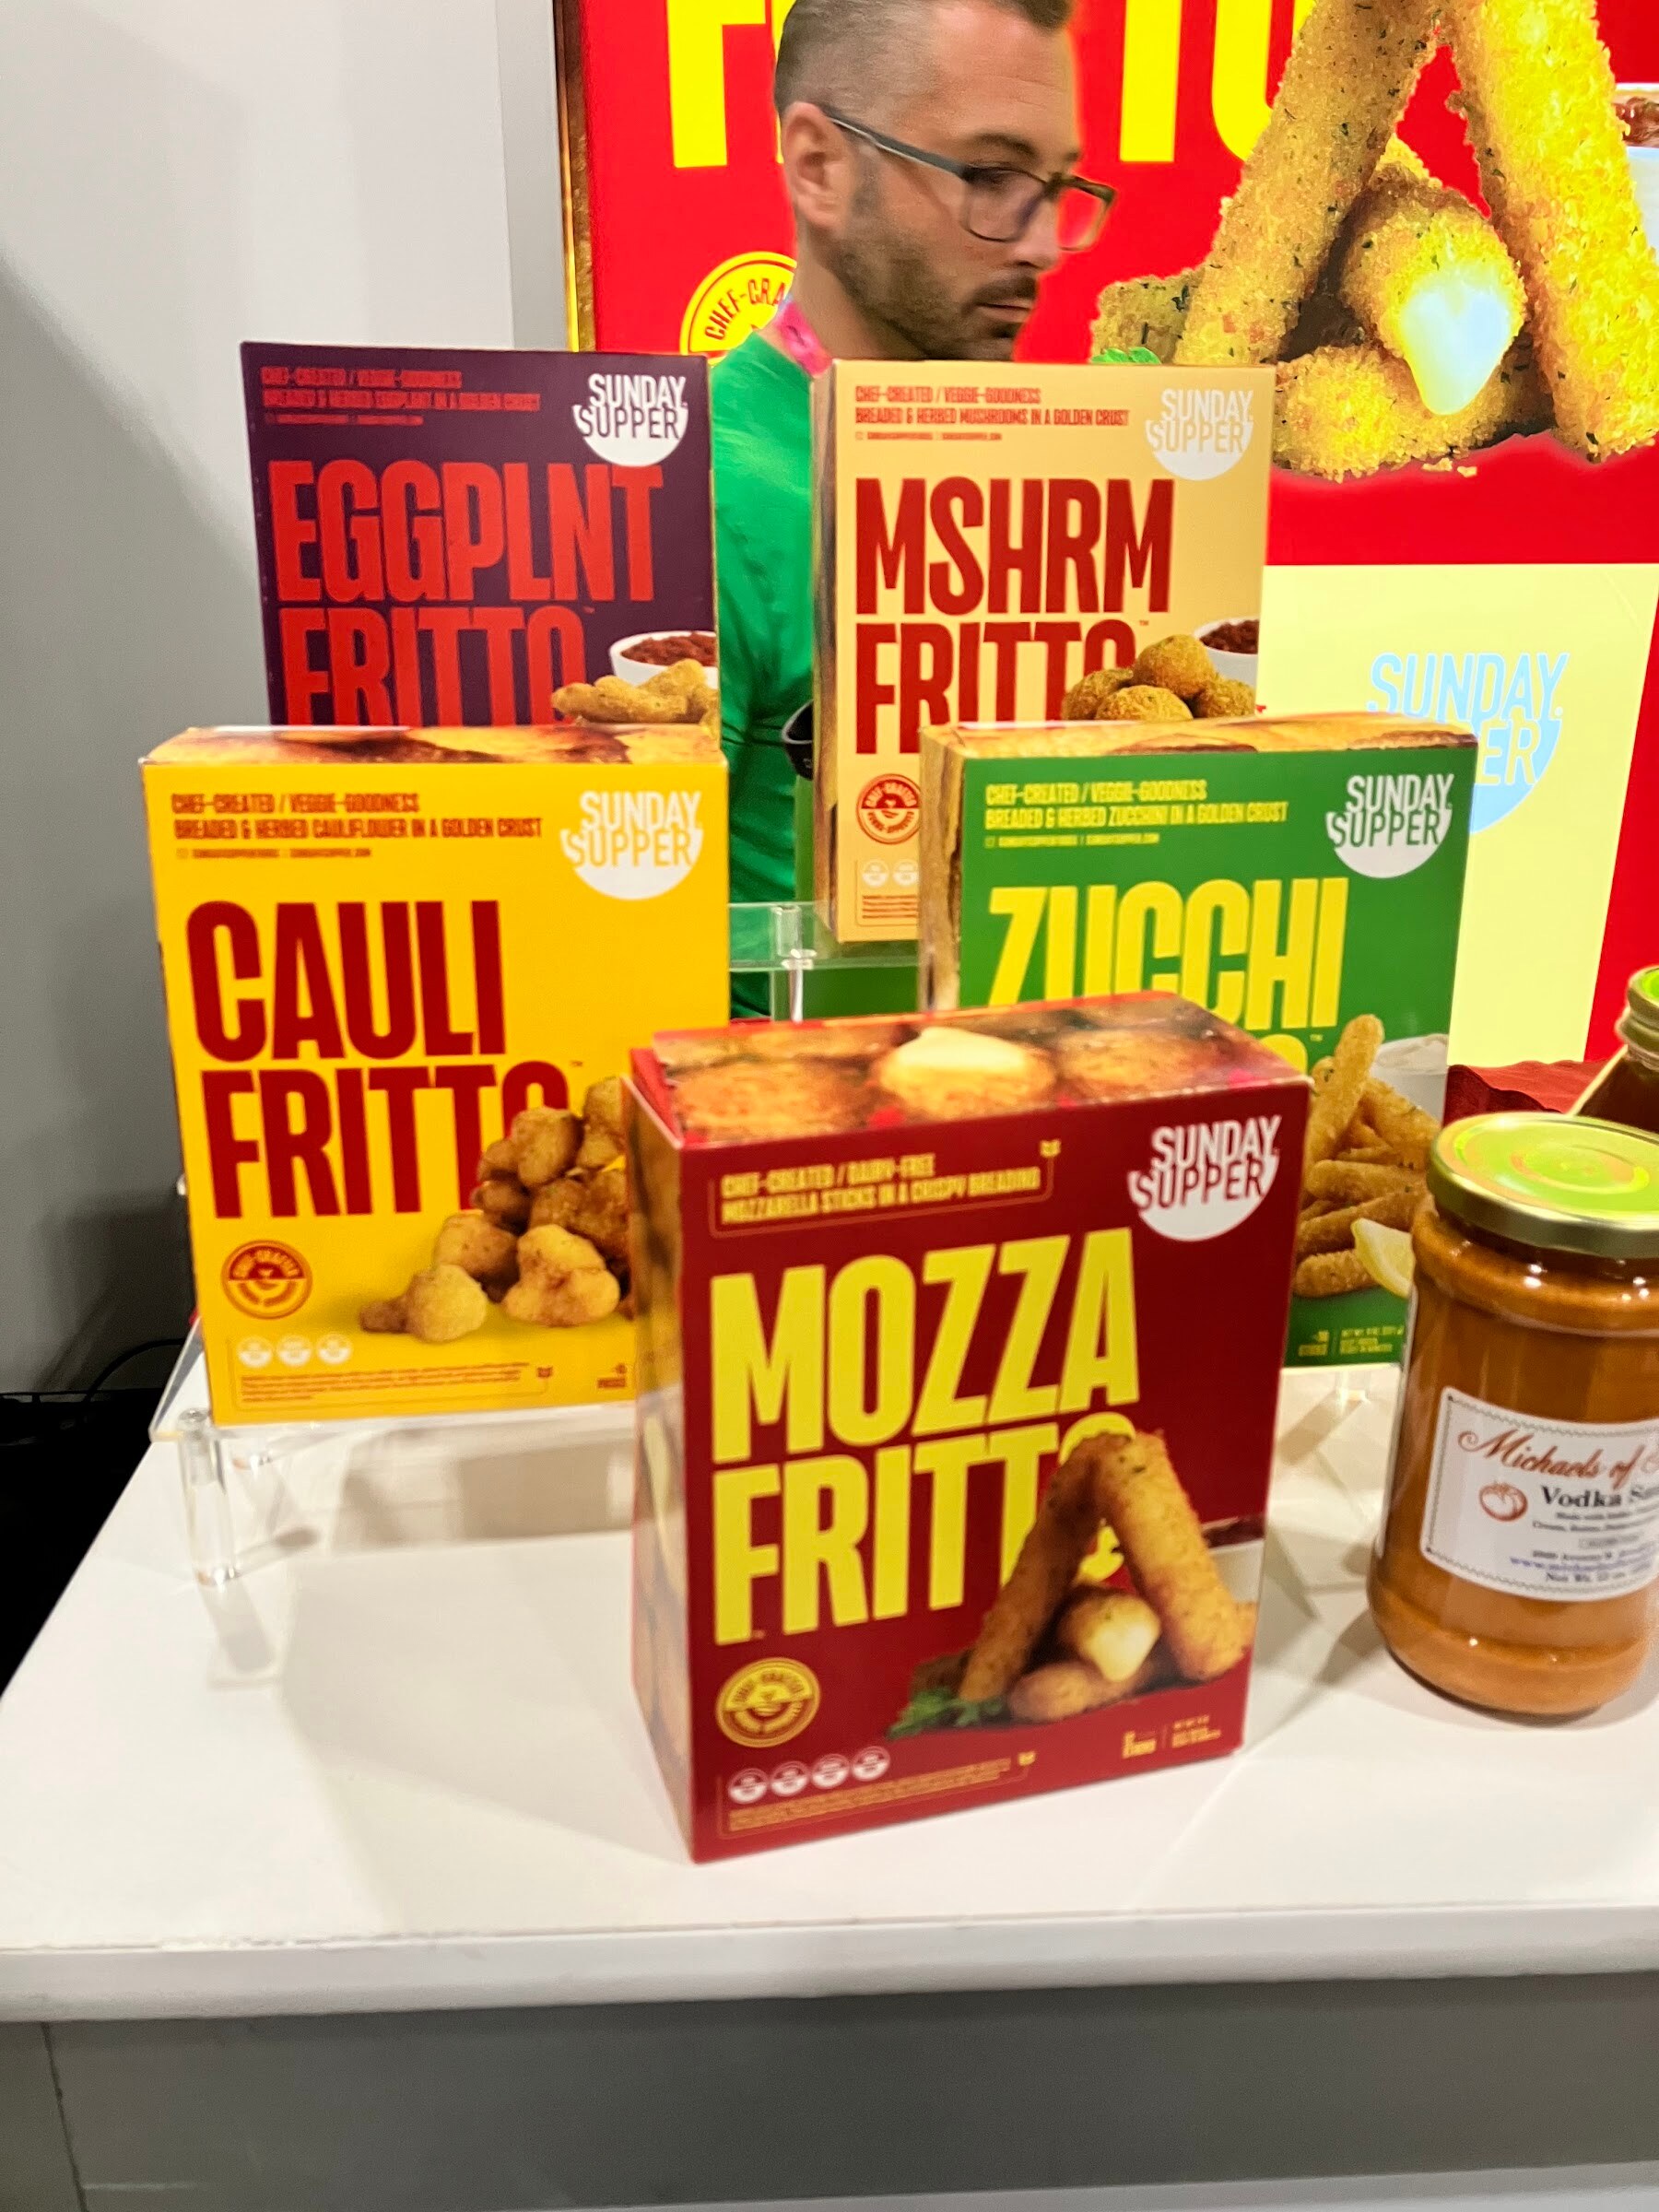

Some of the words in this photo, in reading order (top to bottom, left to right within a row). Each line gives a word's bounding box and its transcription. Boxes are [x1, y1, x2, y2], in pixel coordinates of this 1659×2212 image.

[704, 277, 786, 341] CHEF-CRA
[588, 373, 686, 409] SUNDAY
[1159, 388, 1253, 423] SUNDAY
[581, 406, 680, 440] SUPPER
[959, 408, 1029, 425] MUSHROOMS
[1030, 408, 1042, 425] IN
[1044, 409, 1052, 425] A
[1053, 409, 1093, 426] GOLDEN
[1095, 409, 1130, 426] CRUST
[1149, 420, 1244, 453] SUPPER
[268, 459, 664, 602] EGGPLNT
[855, 477, 1174, 616] MSHRM
[1367, 653, 1570, 724] SUNDAY
[579, 791, 702, 831] SUNDAY
[1346, 773, 1454, 813] SUNDAY
[1108, 805, 1169, 827] ZUCCHINI
[1171, 804, 1183, 825] IN
[1186, 804, 1194, 824] A
[1197, 803, 1244, 823] GOLDEN
[1332, 809, 1441, 848] SUPPER
[568, 830, 694, 867] SUPPER
[988, 877, 1349, 1030] ZUCCHI
[186, 900, 506, 1062] CAULI
[1150, 1115, 1281, 1172] SUNDAY
[722, 1191, 818, 1226] MOZZARELLA
[821, 1184, 877, 1214] STICKS
[878, 1182, 897, 1208] IN
[899, 1181, 909, 1205] A
[1136, 1160, 1266, 1210] SUPPER
[710, 1227, 1140, 1464] MOZZA
[1458, 1429, 1604, 1478] Michaels
[1609, 1442, 1645, 1490] of
[1541, 1485, 1622, 1508] Vodka
